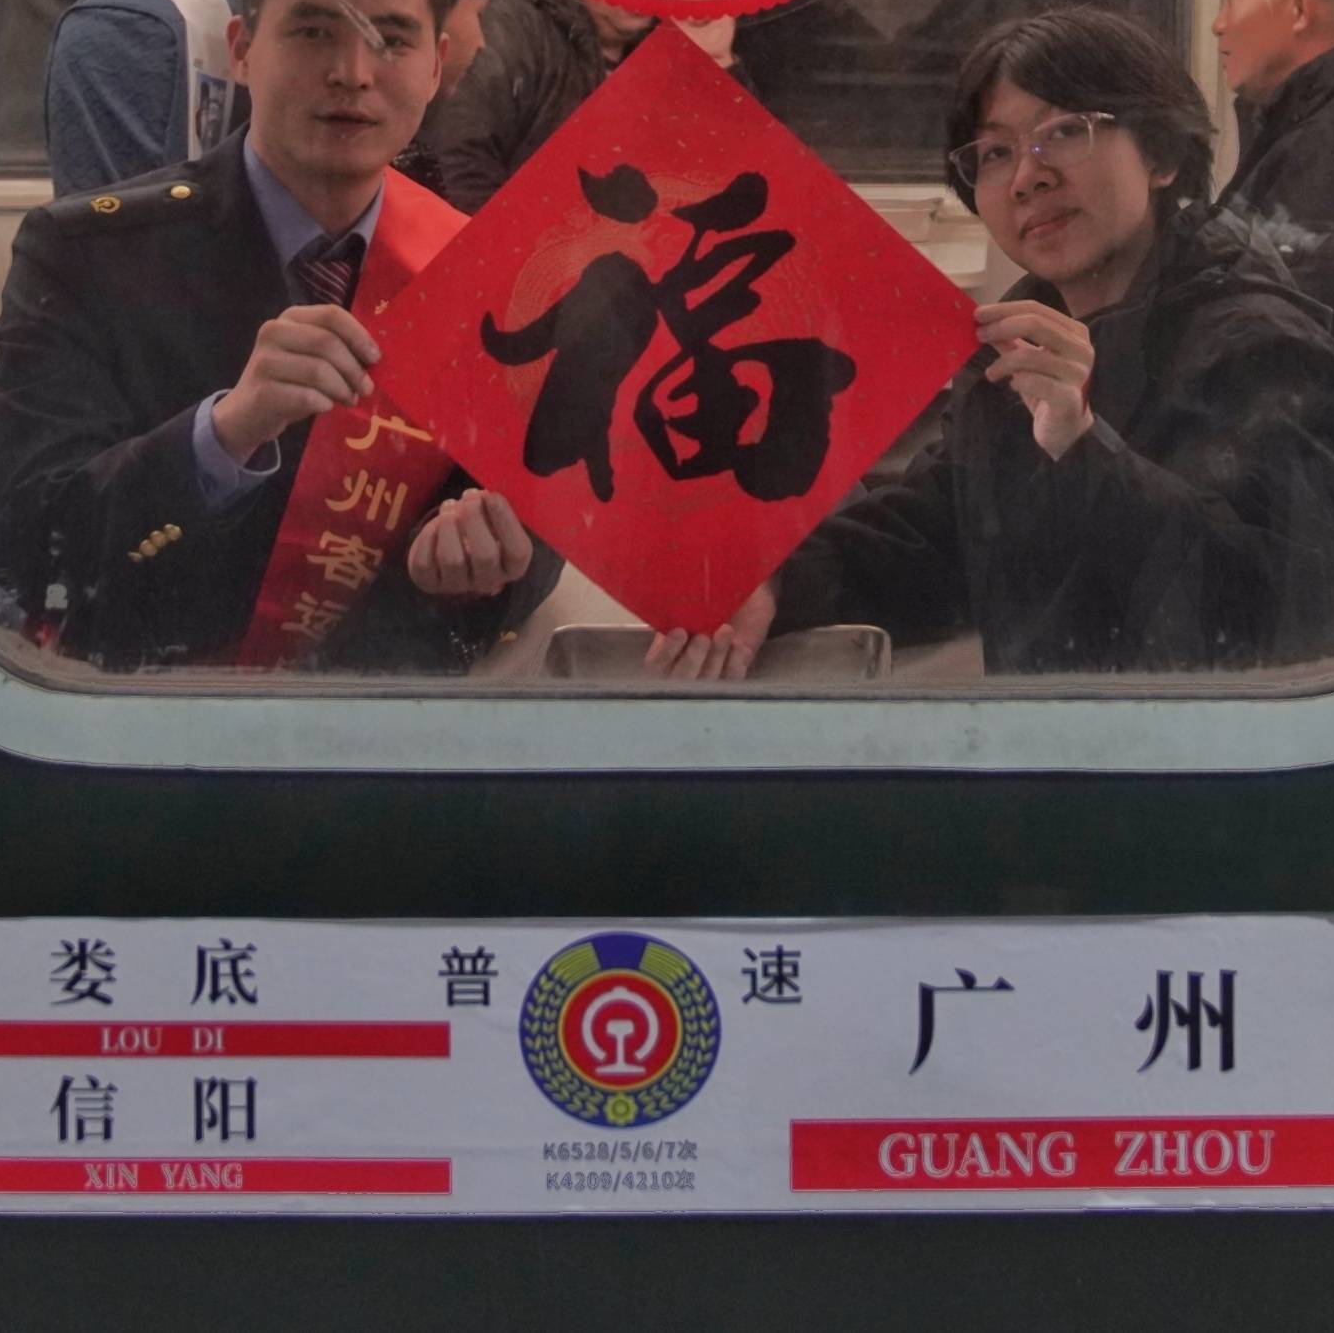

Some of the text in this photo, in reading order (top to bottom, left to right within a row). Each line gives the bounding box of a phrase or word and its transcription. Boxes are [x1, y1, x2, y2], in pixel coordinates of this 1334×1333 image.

[480, 163, 856, 502] 福
[50, 937, 258, 1007] 娄底
[438, 944, 803, 1007] 普 速
[101, 1026, 226, 1054] LOU DI
[909, 967, 1238, 1075] 广州
[50, 1074, 258, 1144] 信阳
[83, 1162, 244, 1190] XIN YANG
[877, 1129, 1276, 1179] GUANG ZHOU
